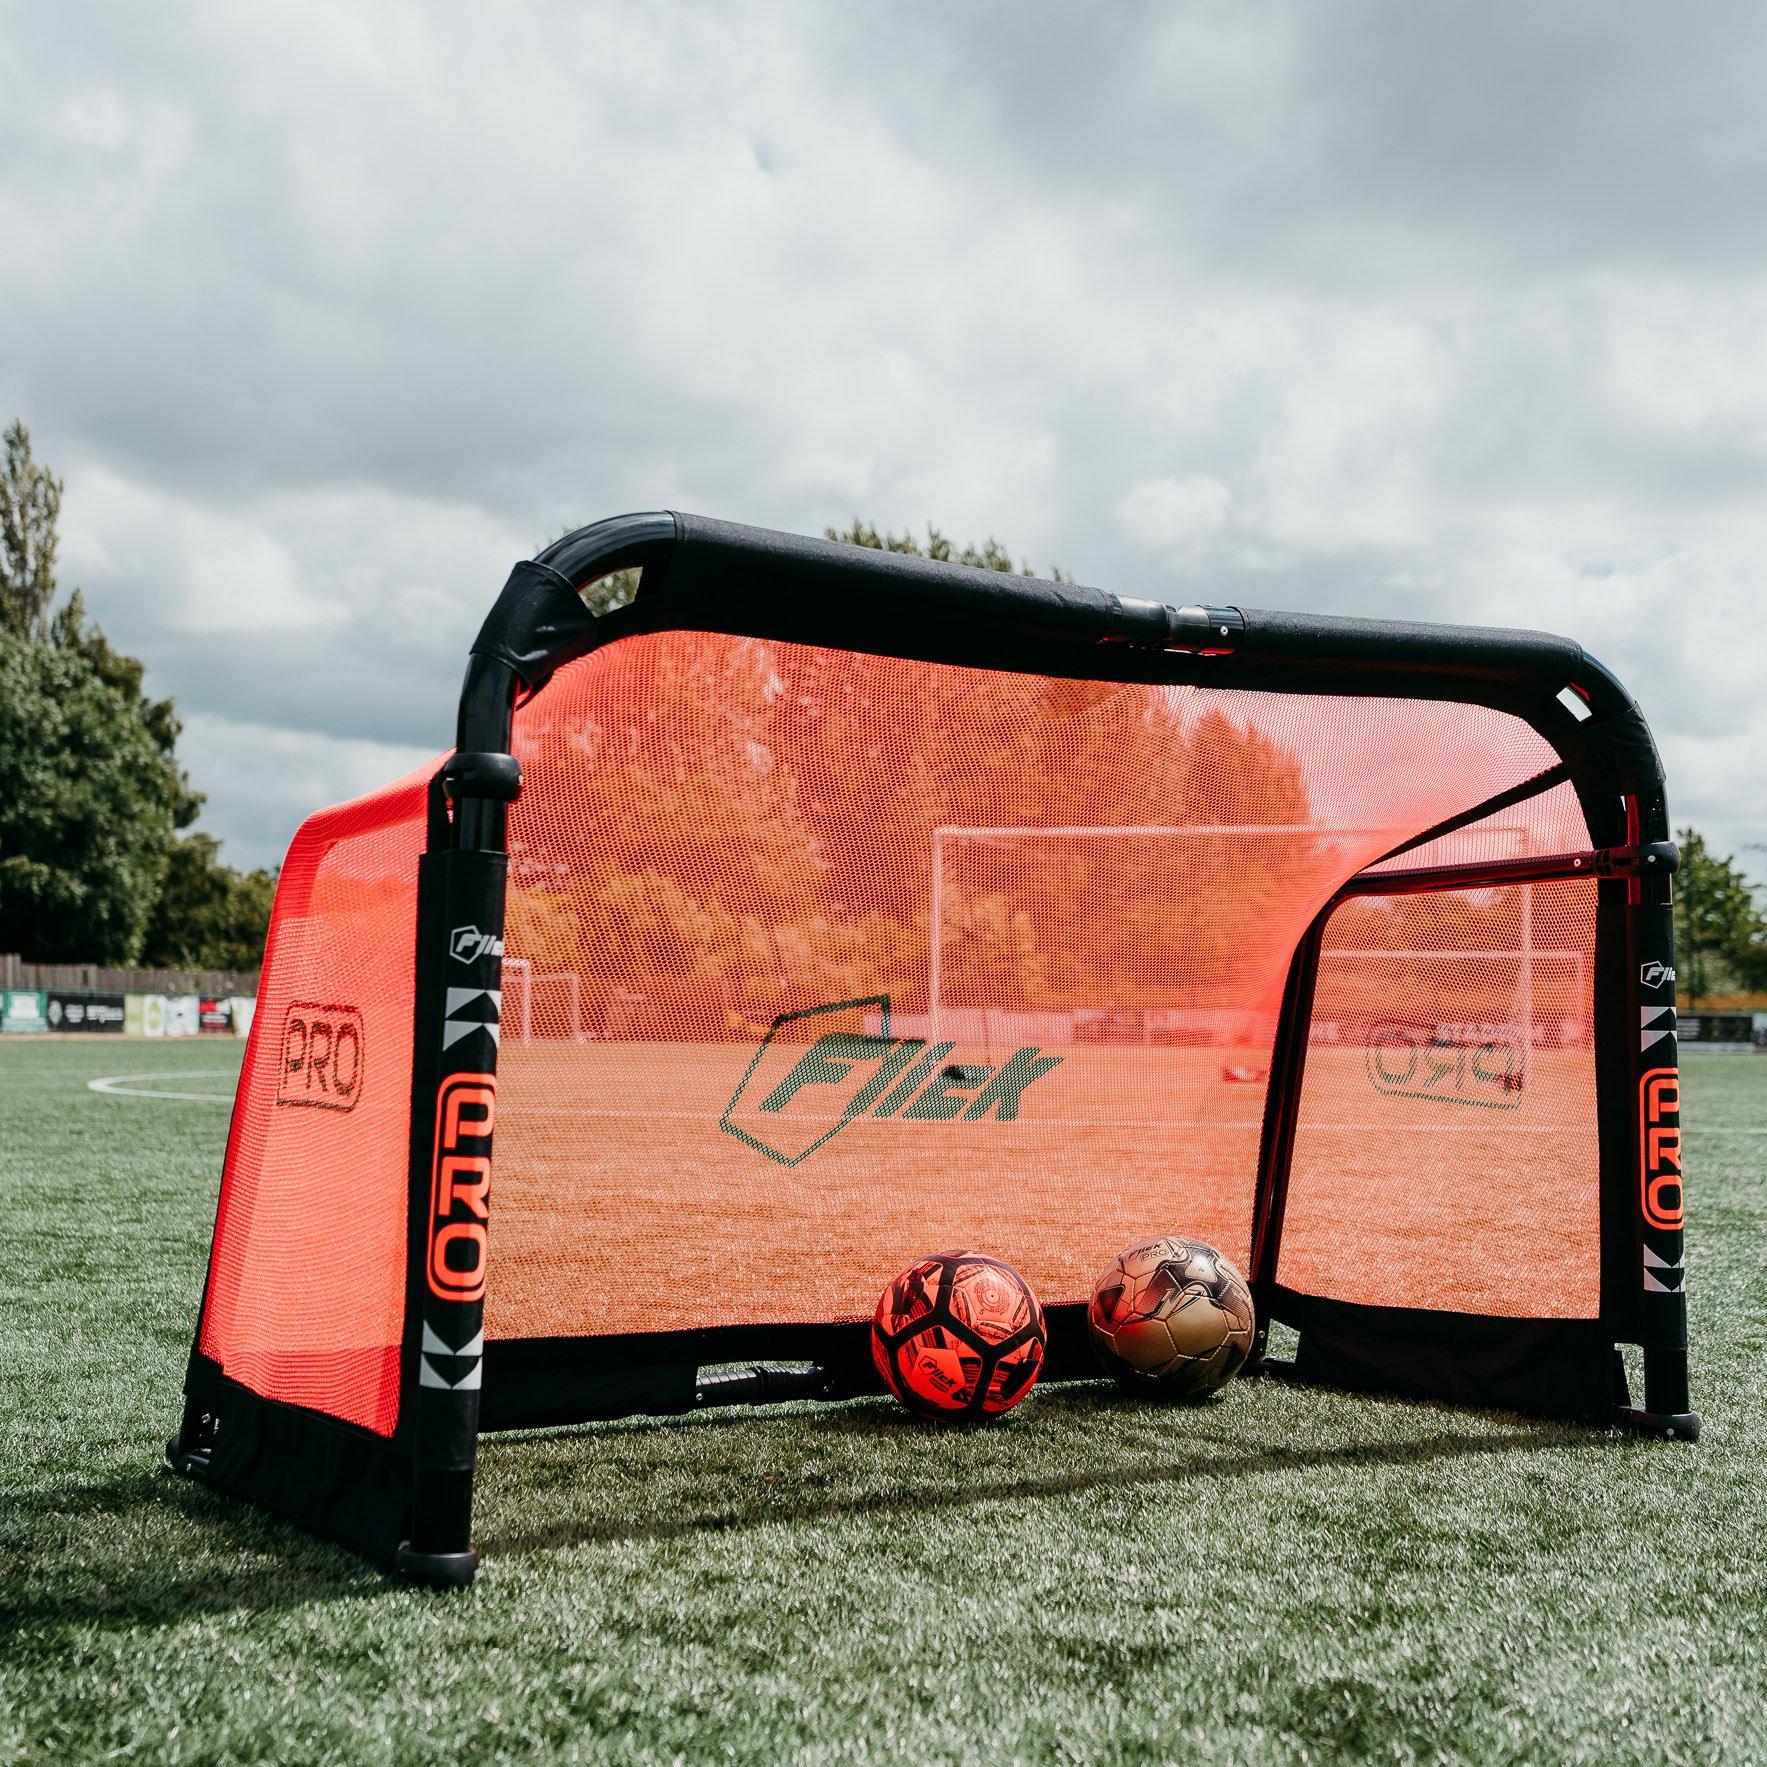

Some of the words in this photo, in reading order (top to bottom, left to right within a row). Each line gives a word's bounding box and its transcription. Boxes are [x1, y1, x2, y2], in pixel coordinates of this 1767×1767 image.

[284, 1018, 360, 1097] PRO
[760, 1032, 1064, 1122] Flick
[432, 1087, 495, 1287] PRO
[1648, 1079, 1684, 1221] PRO
[1128, 1243, 1162, 1259] Flick
[1142, 1249, 1167, 1261] PRO
[921, 1361, 957, 1388] Flick
